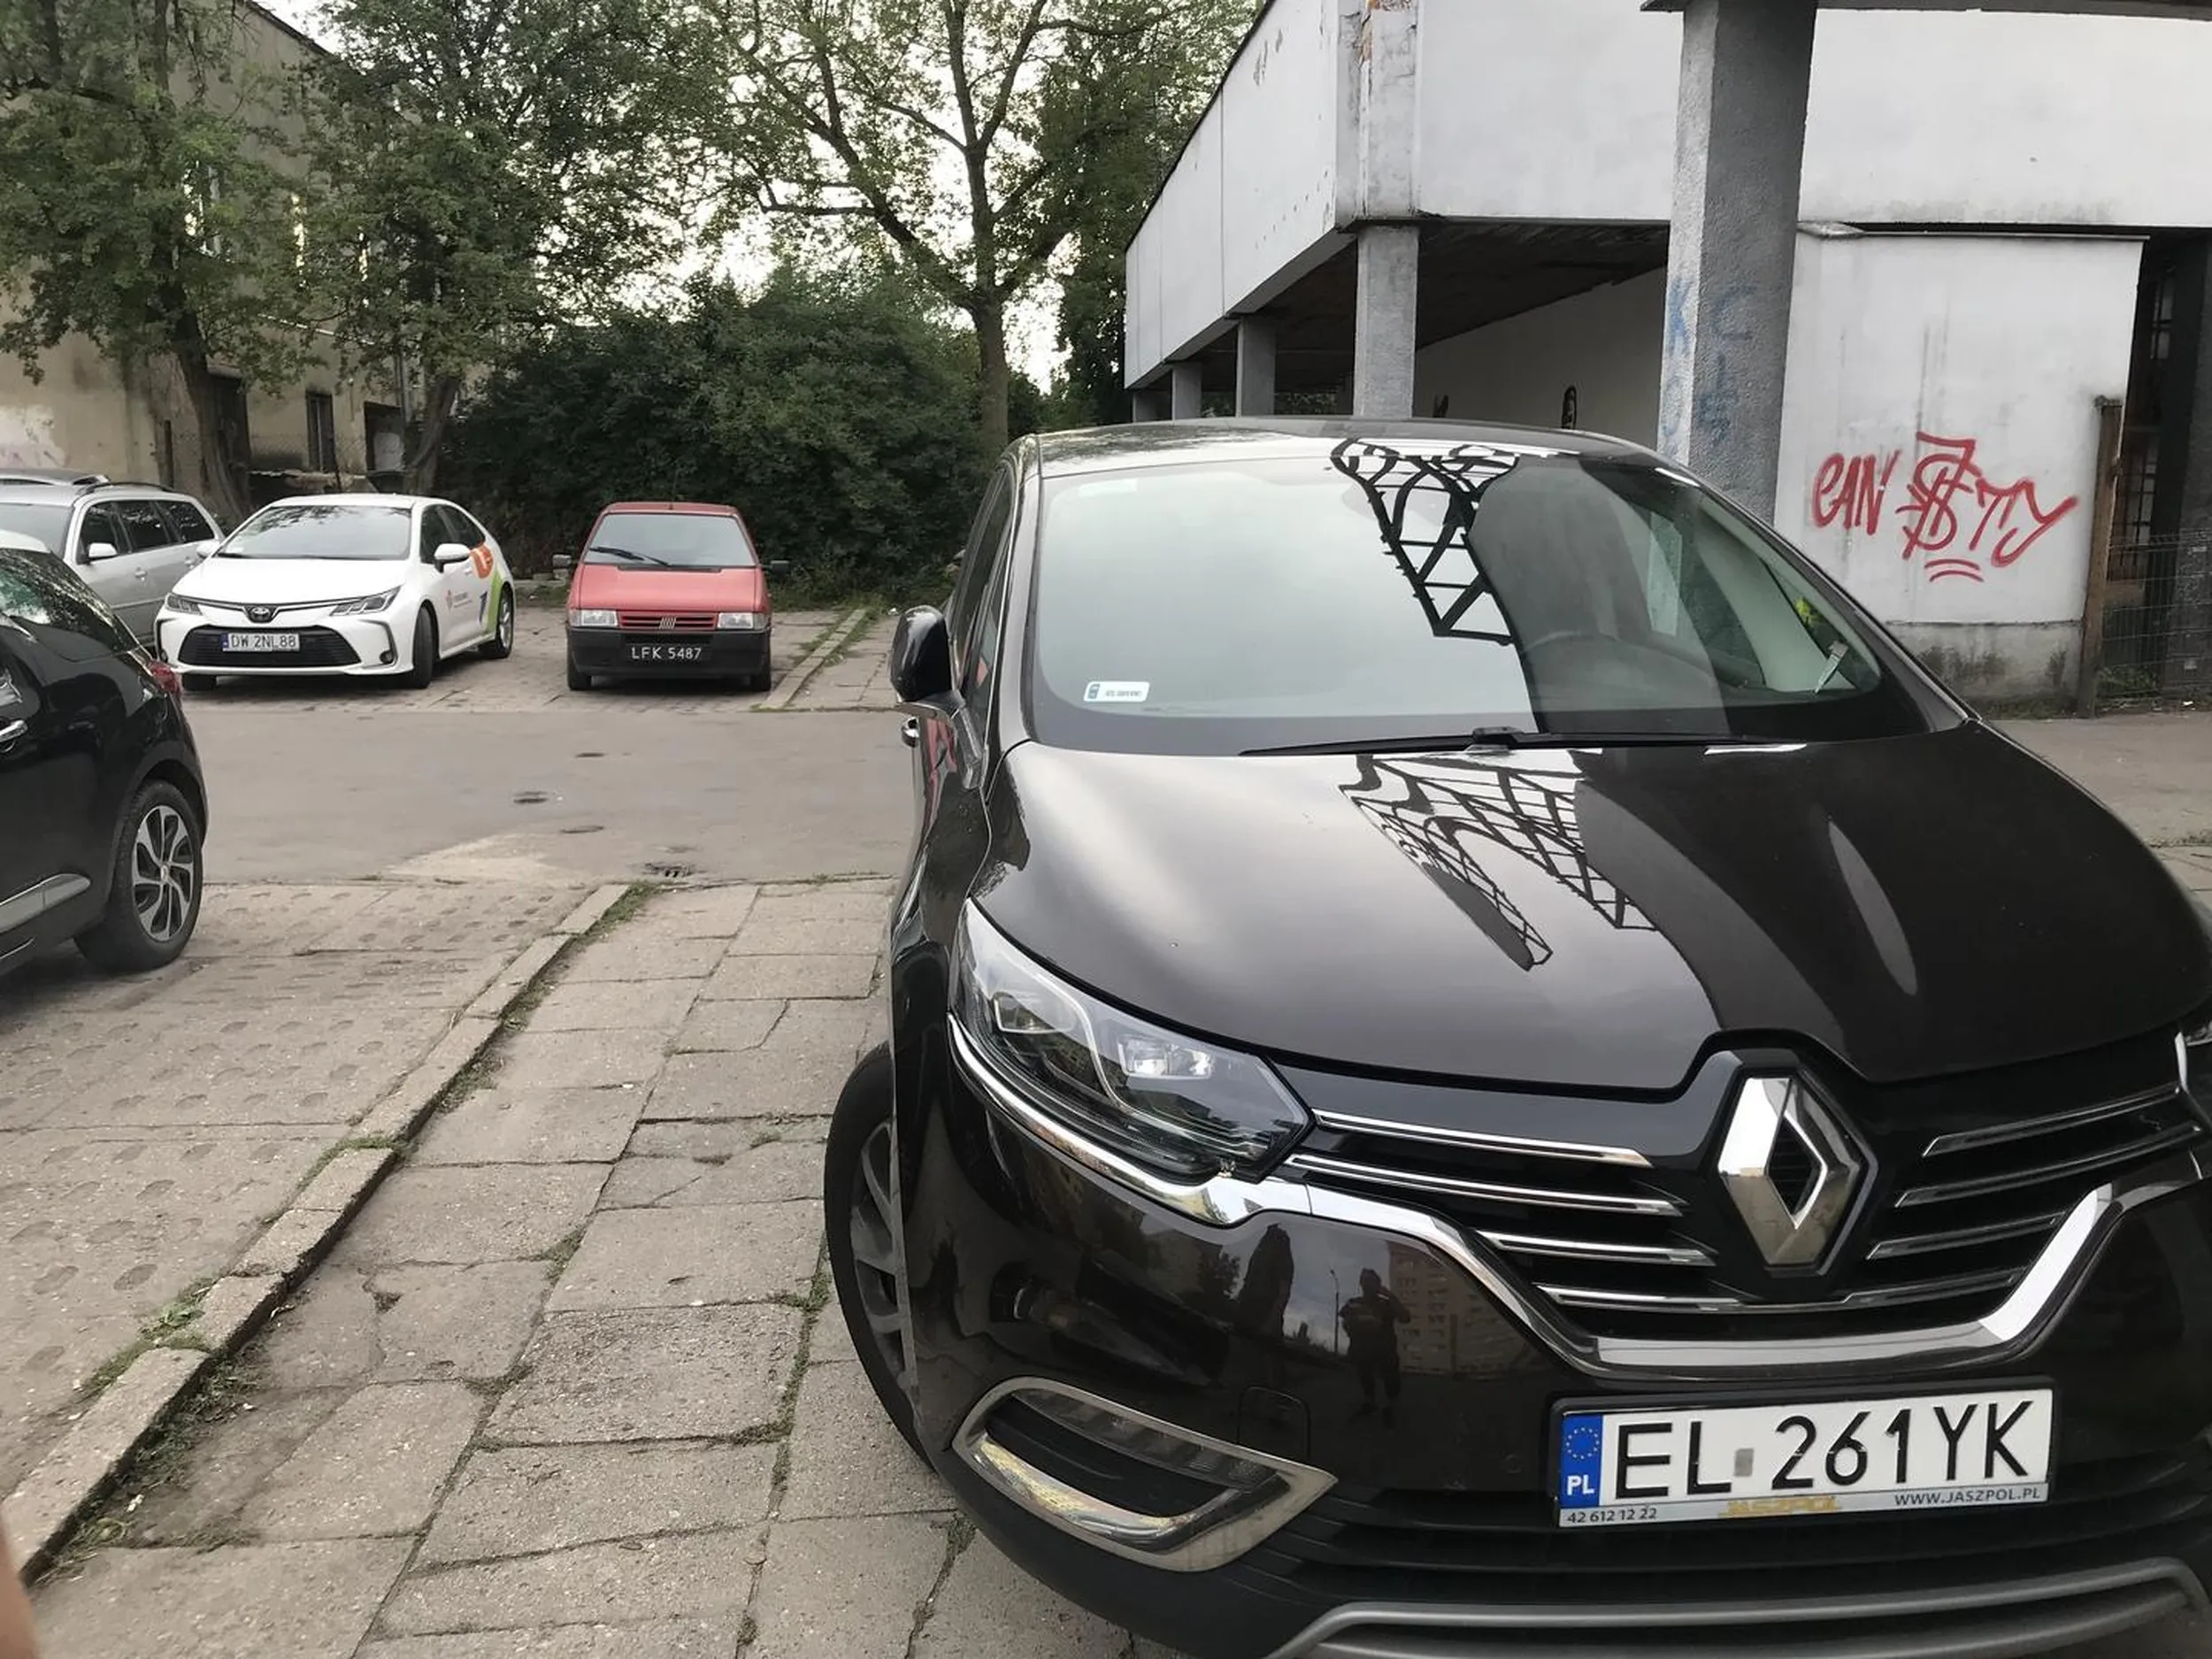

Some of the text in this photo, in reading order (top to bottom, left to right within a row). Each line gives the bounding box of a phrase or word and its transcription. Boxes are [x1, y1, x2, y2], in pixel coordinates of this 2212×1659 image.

[232, 634, 249, 649] DW
[631, 646, 702, 659] LFK 5487
[1615, 1400, 2033, 1501] EL 261YK
[1566, 1474, 1594, 1496] PL
[1893, 1486, 2040, 1506] WWW.JASZPOL.PL
[1566, 1507, 1657, 1524] 42 612 12 22
